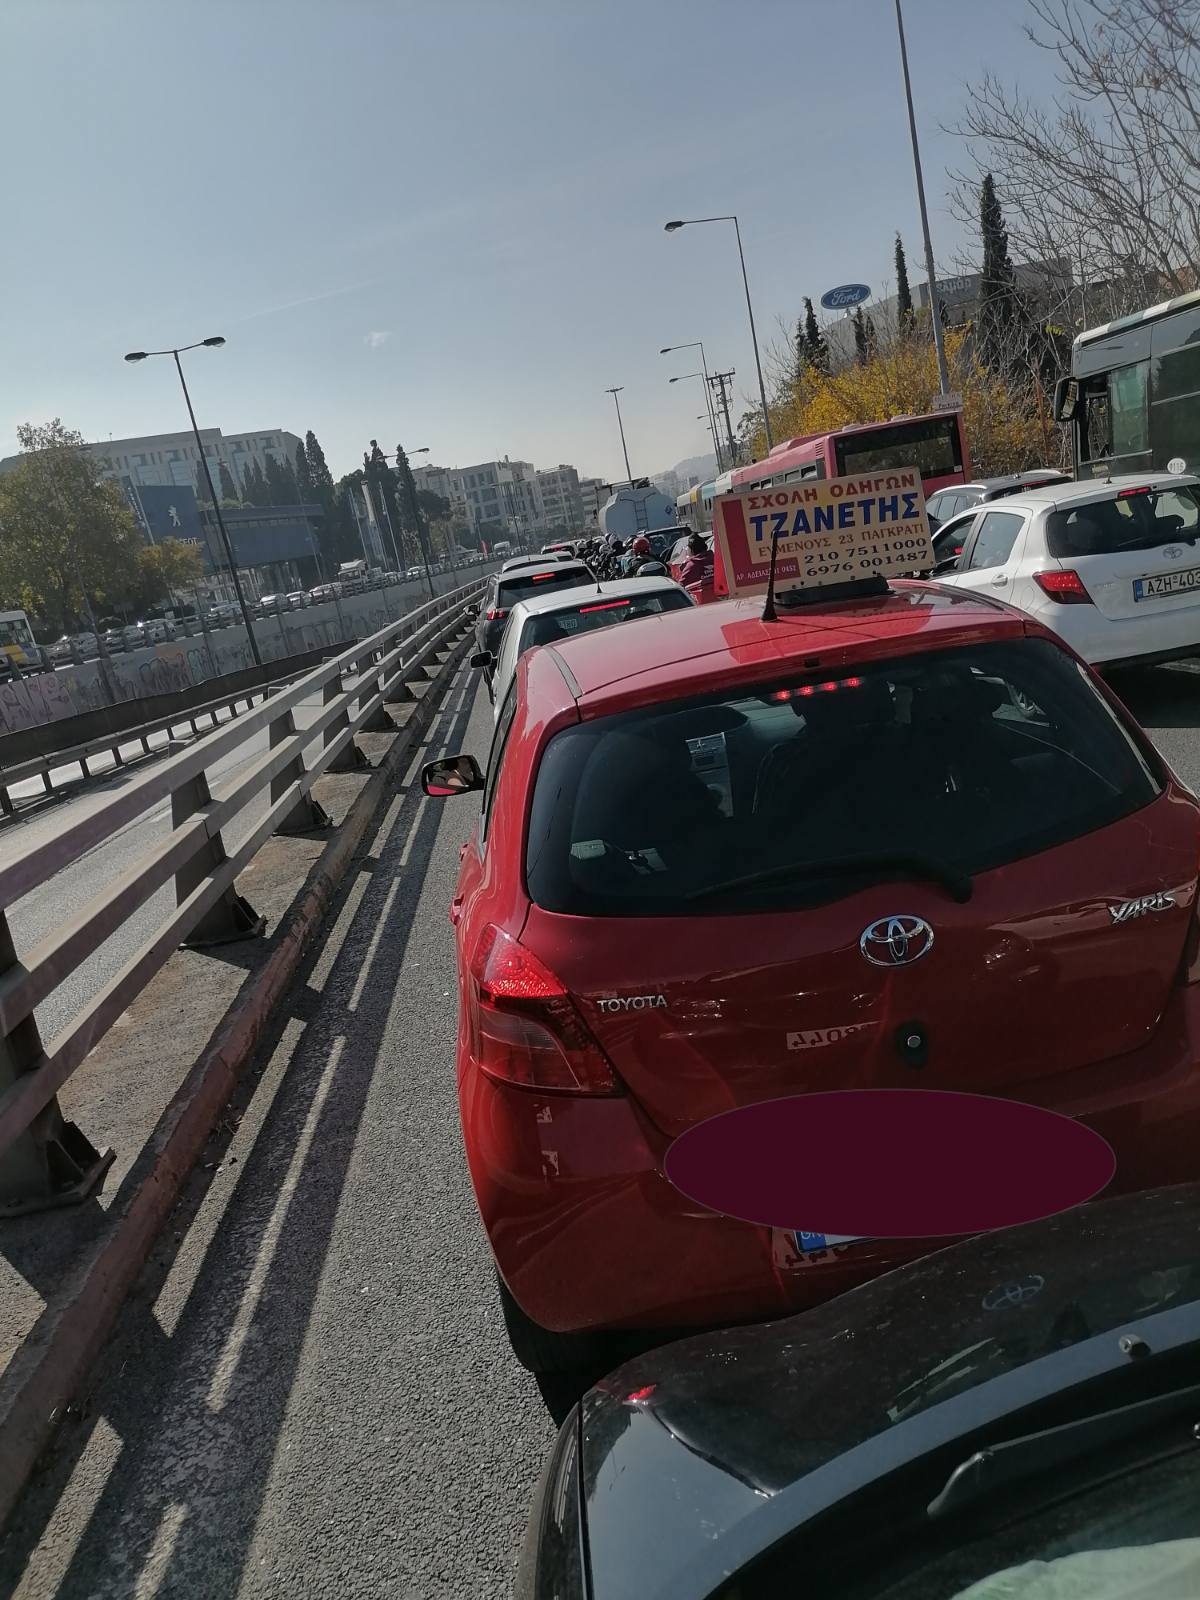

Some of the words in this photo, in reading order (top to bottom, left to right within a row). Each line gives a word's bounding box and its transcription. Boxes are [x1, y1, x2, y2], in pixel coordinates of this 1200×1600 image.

[831, 288, 862, 306] Ford
[748, 488, 818, 510] ΣΧΟΛΗ
[831, 474, 915, 498] ΟΔΗΓΩΝ
[749, 492, 920, 541] ΤΖΑΝΕΤΗΣ
[839, 534, 854, 545] 23
[861, 523, 925, 541] ΠΑΓΚΡΑΤΙ
[804, 551, 839, 564] 210
[846, 537, 927, 558] 7511000
[806, 561, 854, 577] 6976
[860, 550, 928, 569] 001487
[1108, 890, 1177, 924] YARIS
[597, 995, 668, 1013] TOYOTA
